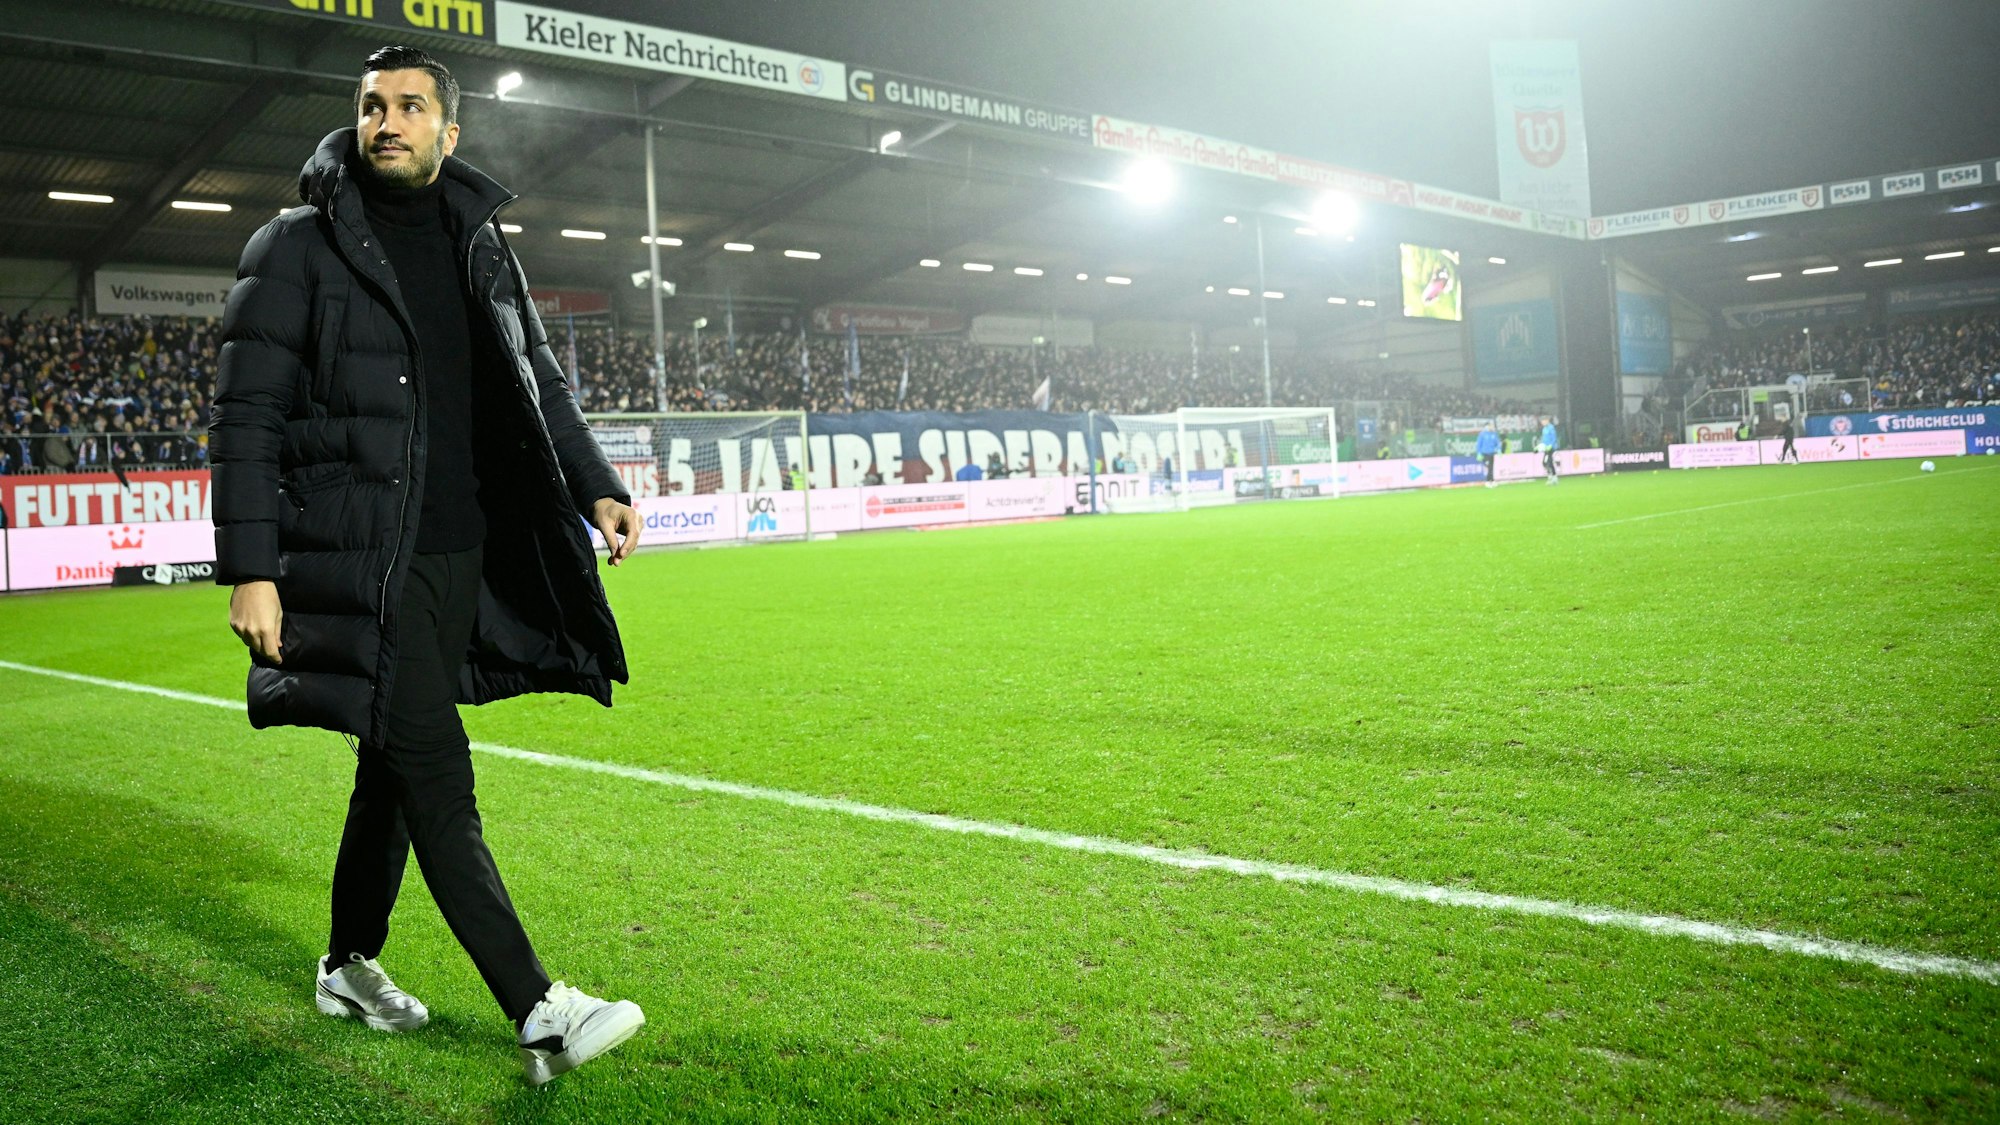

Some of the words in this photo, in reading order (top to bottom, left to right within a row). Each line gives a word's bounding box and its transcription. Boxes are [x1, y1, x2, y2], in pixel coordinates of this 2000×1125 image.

[524, 13, 616, 53] Kieler
[624, 30, 788, 83] Nachrichten
[885, 80, 1021, 125] GLINDEMANN
[1024, 108, 1089, 138] GRUPPE
[1728, 191, 1799, 211] FLENKER
[1606, 210, 1671, 227] FLENKER
[111, 284, 215, 306] Volkswagen
[1891, 412, 1986, 430] STÖRCHECLUB
[1696, 426, 1737, 444] famil
[667, 438, 695, 496] 5
[746, 497, 776, 514] UCA
